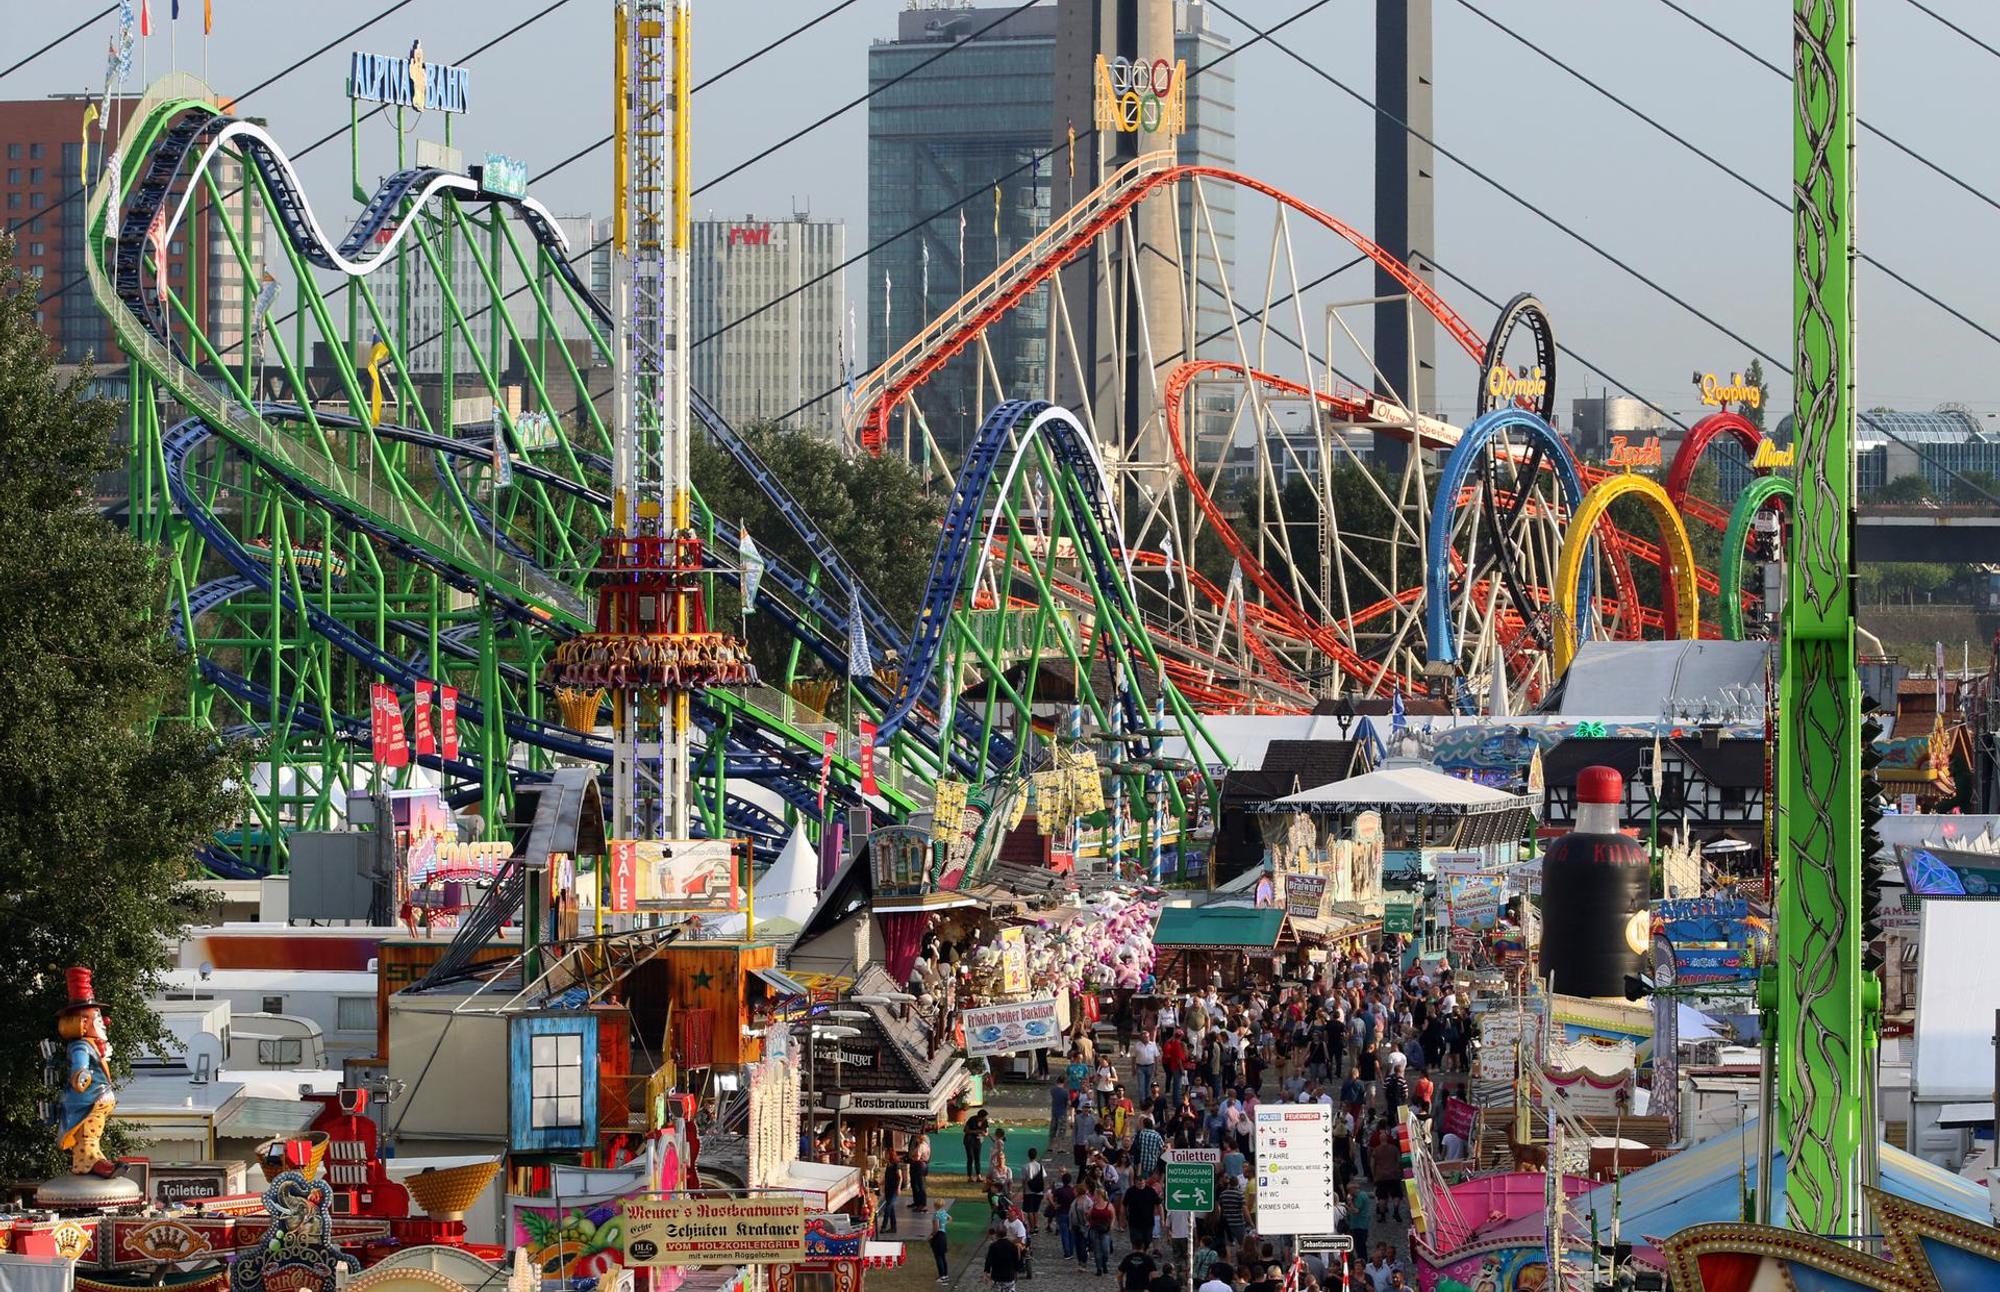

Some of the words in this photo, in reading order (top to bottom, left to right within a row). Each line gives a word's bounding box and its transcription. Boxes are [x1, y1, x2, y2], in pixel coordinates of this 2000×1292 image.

[353, 51, 413, 107] ALPINA
[424, 62, 470, 114] BAHN
[1489, 365, 1547, 400] Olympia
[1700, 373, 1760, 409] Looping
[617, 844, 630, 910] SALE
[854, 1098, 929, 1109] Rostbratwurst
[1171, 1150, 1216, 1162] Toiletten
[1168, 1168, 1211, 1176] NOTAUSGANG
[163, 1184, 214, 1196] Toiletten
[697, 1204, 800, 1218] Rostbratwurst
[634, 1243, 653, 1251] DLG
[668, 1243, 691, 1251] VOM
[697, 1240, 798, 1250] HOLZKOHLENGRILL
[734, 1251, 780, 1260] Röggelchen
[268, 1268, 323, 1290] CIRCUS
